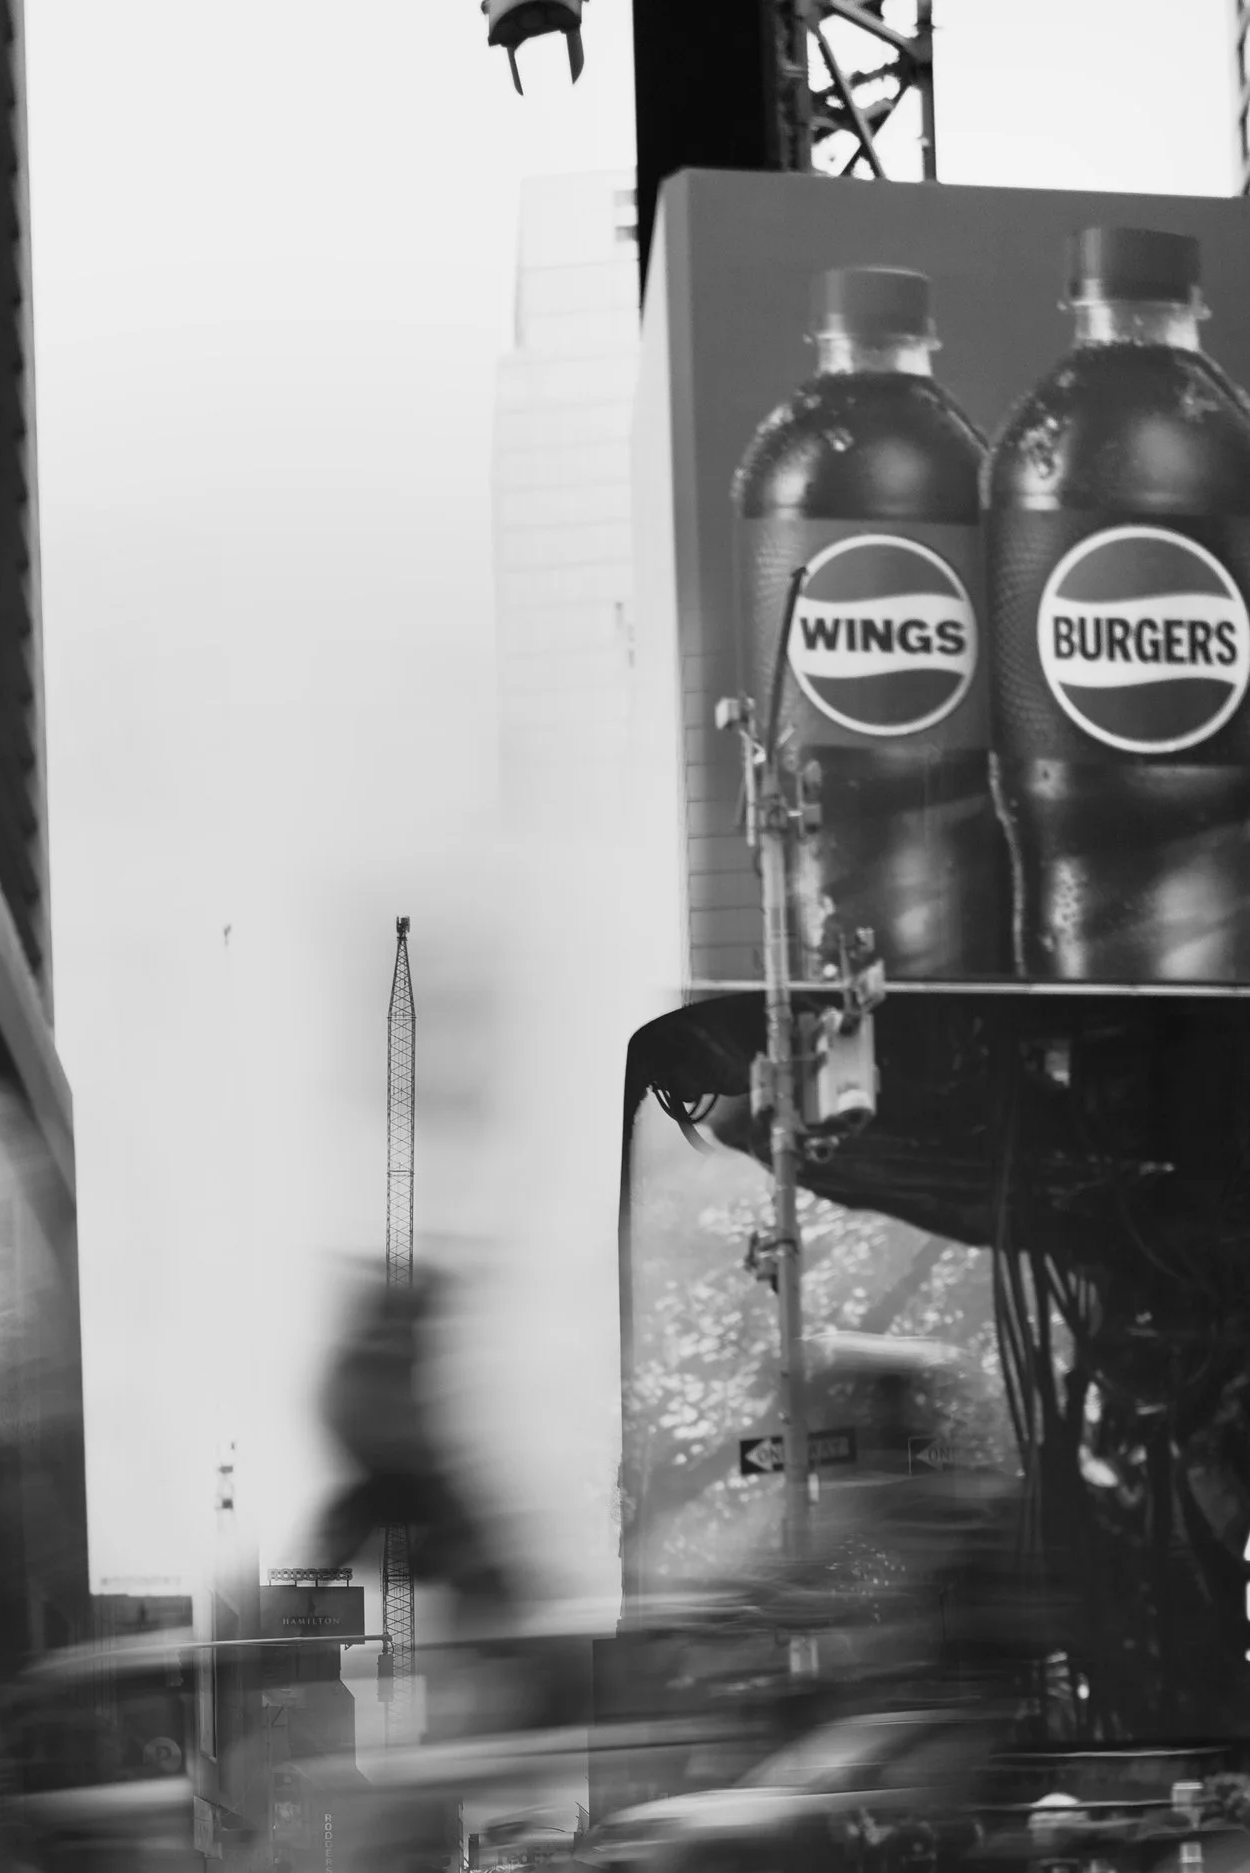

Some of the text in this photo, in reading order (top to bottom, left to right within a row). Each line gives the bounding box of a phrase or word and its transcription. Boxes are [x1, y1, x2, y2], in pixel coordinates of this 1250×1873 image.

[800, 616, 967, 656] WINGS
[1052, 615, 1238, 667] BURGERS
[282, 1616, 342, 1626] HAMILTON
